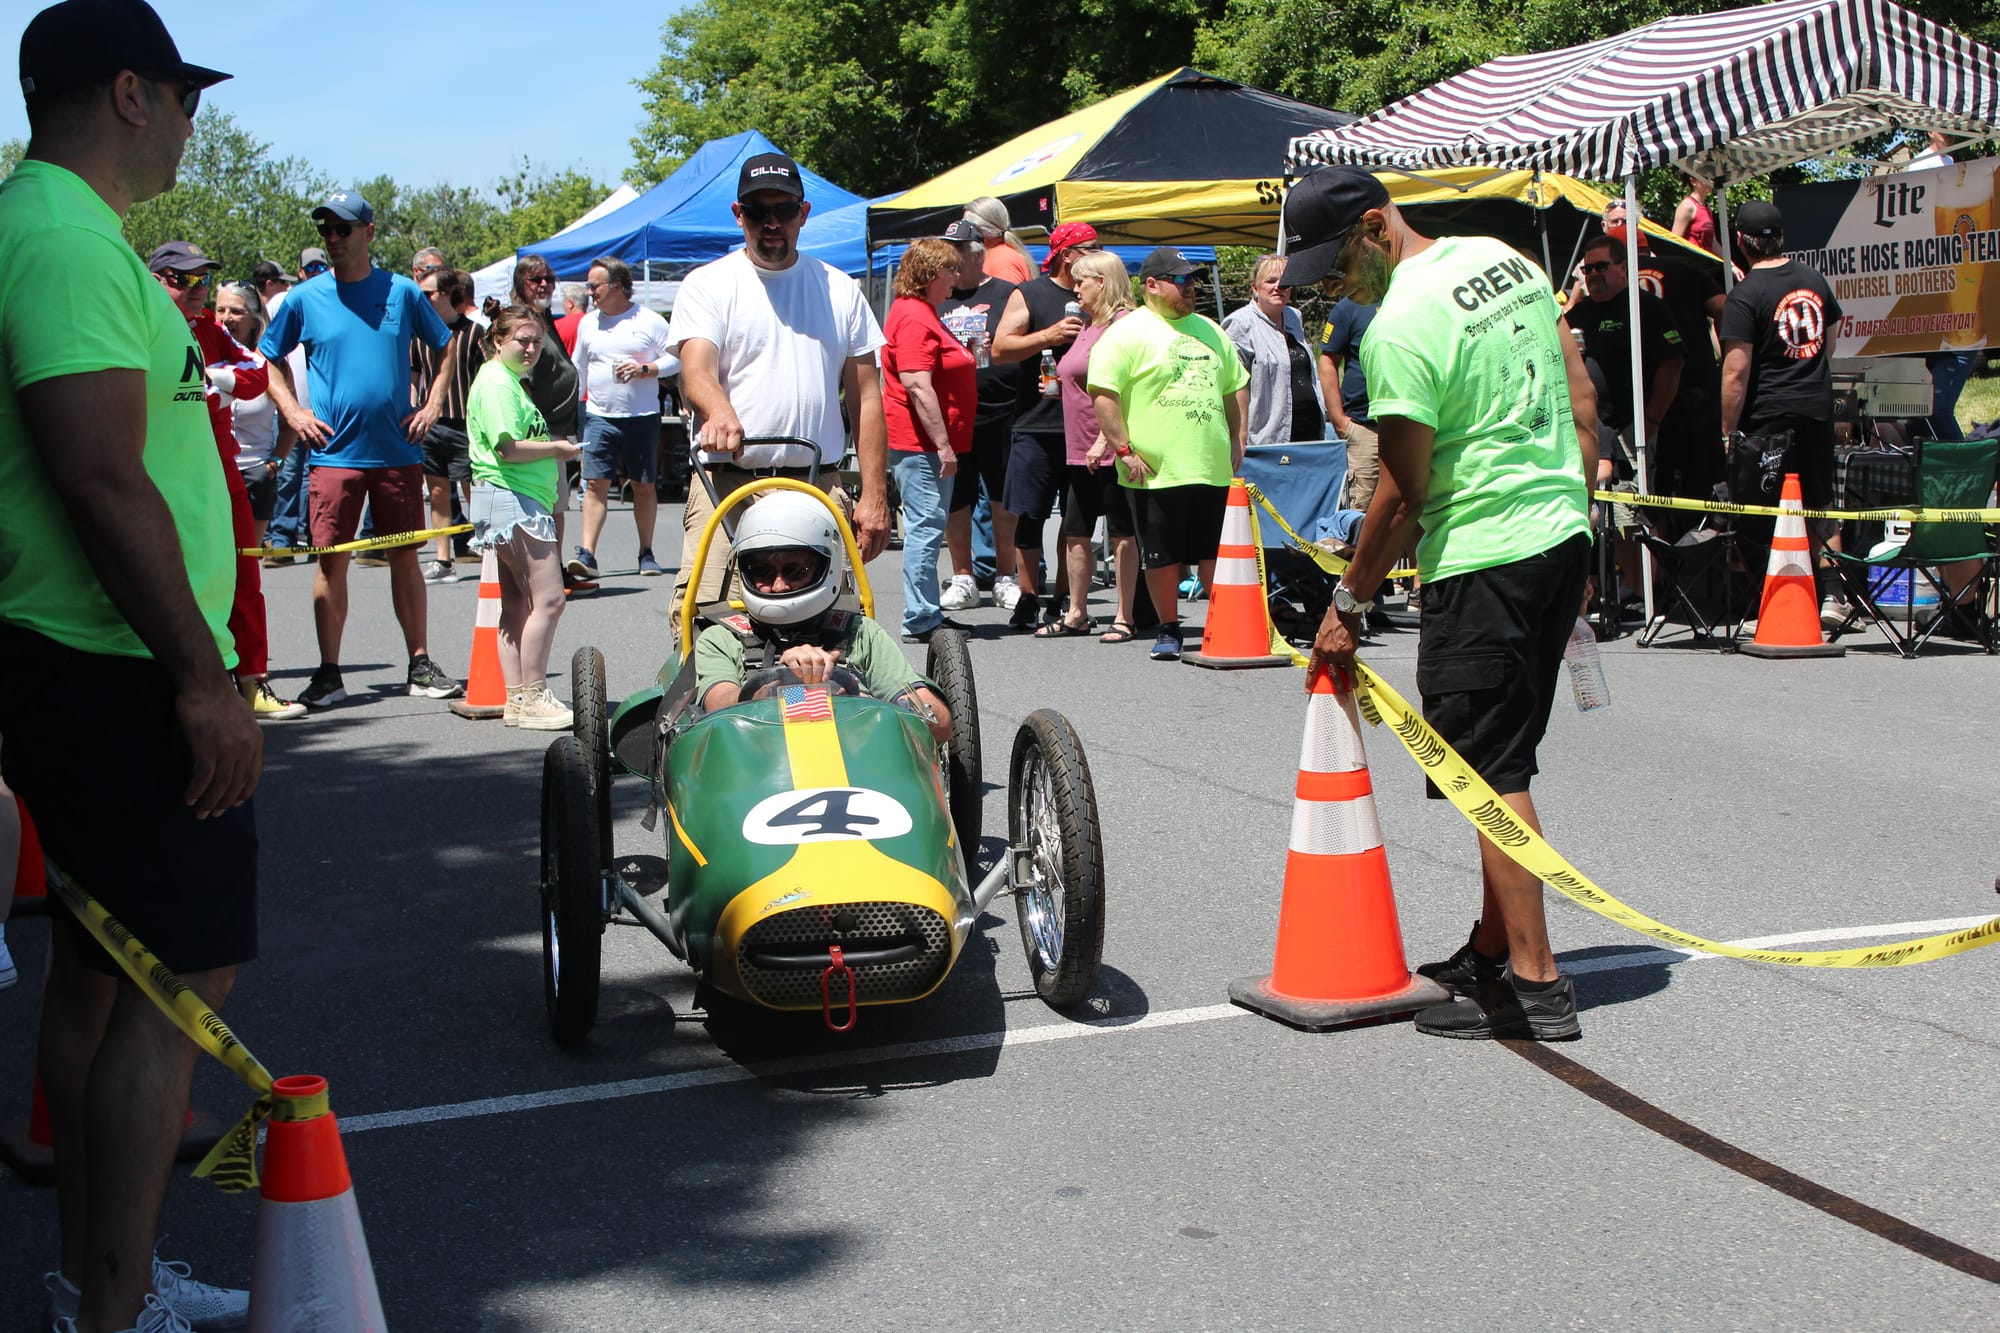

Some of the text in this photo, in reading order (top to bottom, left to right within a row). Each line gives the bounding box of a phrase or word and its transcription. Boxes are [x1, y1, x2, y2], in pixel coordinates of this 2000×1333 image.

[1874, 182, 1926, 228] Lite
[1861, 243, 1899, 273] HOSE
[1904, 235, 1962, 268] RACING
[1967, 230, 2000, 262] TEA
[1452, 257, 1534, 311] CREW
[1835, 270, 1956, 300] NOVERSEL BROTHERS
[1855, 319, 1888, 337] DRAFTS
[1890, 317, 1906, 335] ALL
[1909, 316, 1929, 334] DAY
[1929, 313, 1977, 333] EVERYDAY
[1632, 493, 1673, 505] CAUTION
[1704, 500, 1745, 512] CUIDADO
[1941, 511, 1982, 522] CAUTION
[1393, 711, 1446, 767] CAUTION
[766, 790, 880, 836] 4
[1469, 800, 1530, 847] CUIDADO
